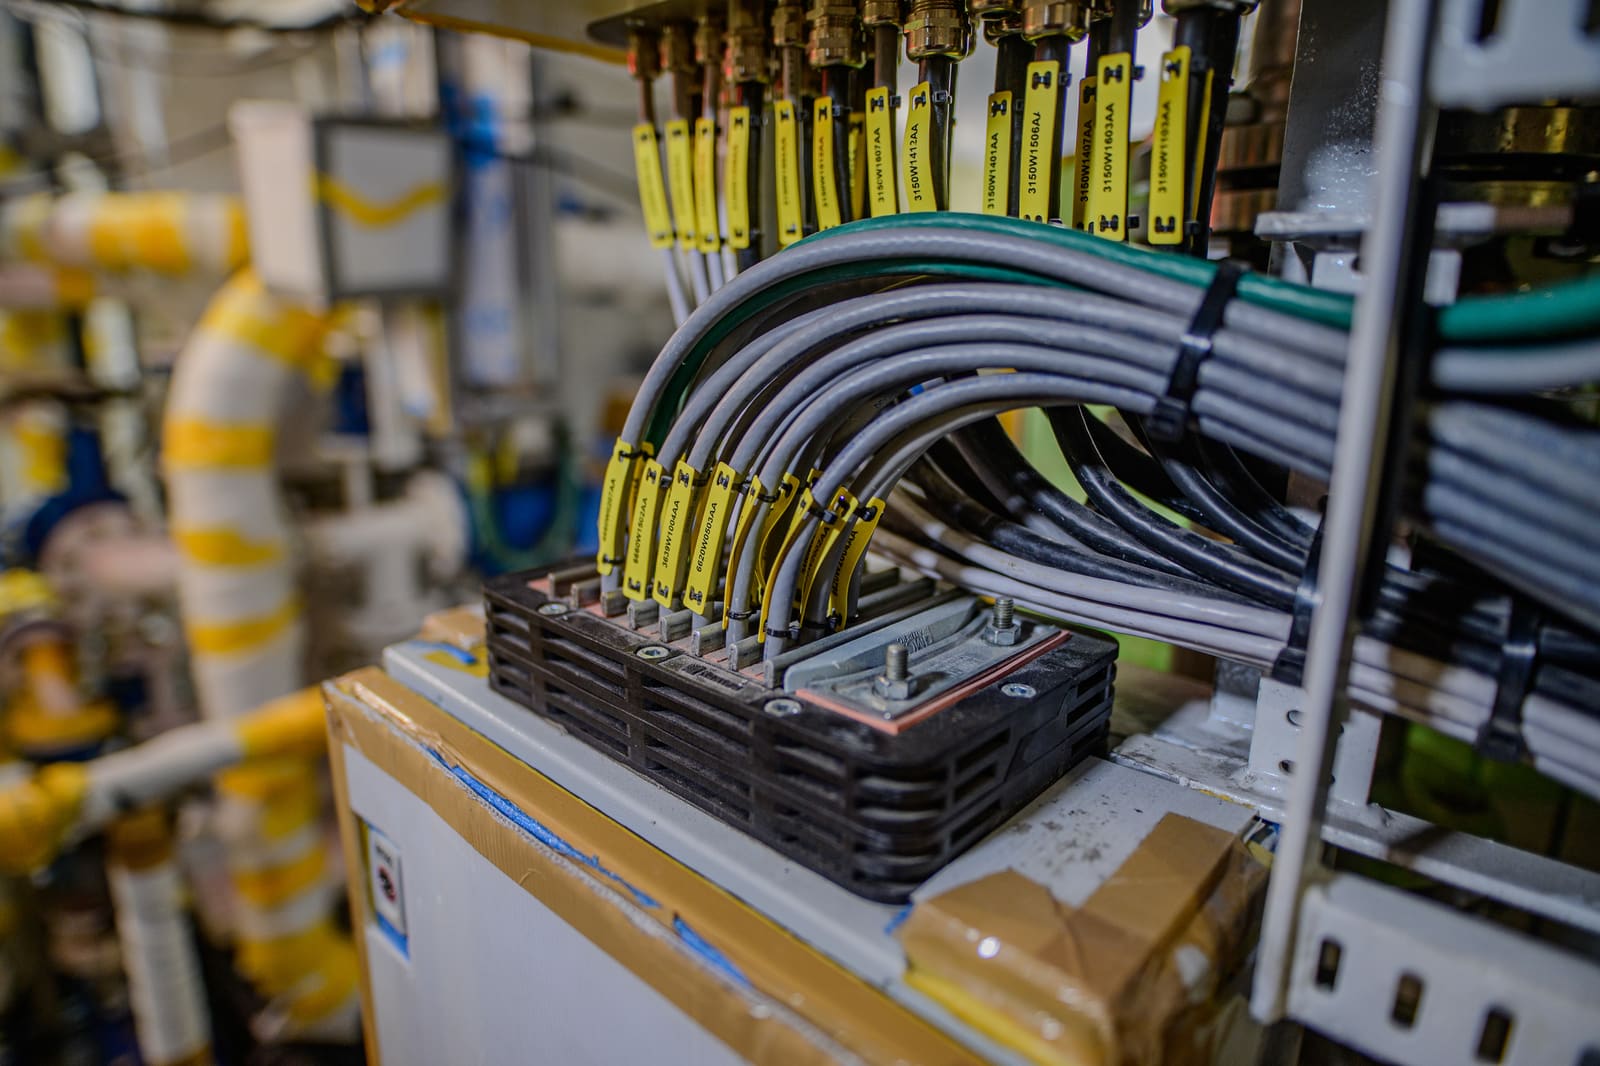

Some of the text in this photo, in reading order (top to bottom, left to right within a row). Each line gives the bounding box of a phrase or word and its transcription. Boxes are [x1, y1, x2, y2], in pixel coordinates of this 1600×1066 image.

[910, 123, 922, 201] 3150W1412AA
[987, 133, 1000, 210] 3150W1401AA
[662, 500, 681, 568] 3639W1004AA
[696, 502, 718, 573] 6620W0503AA
